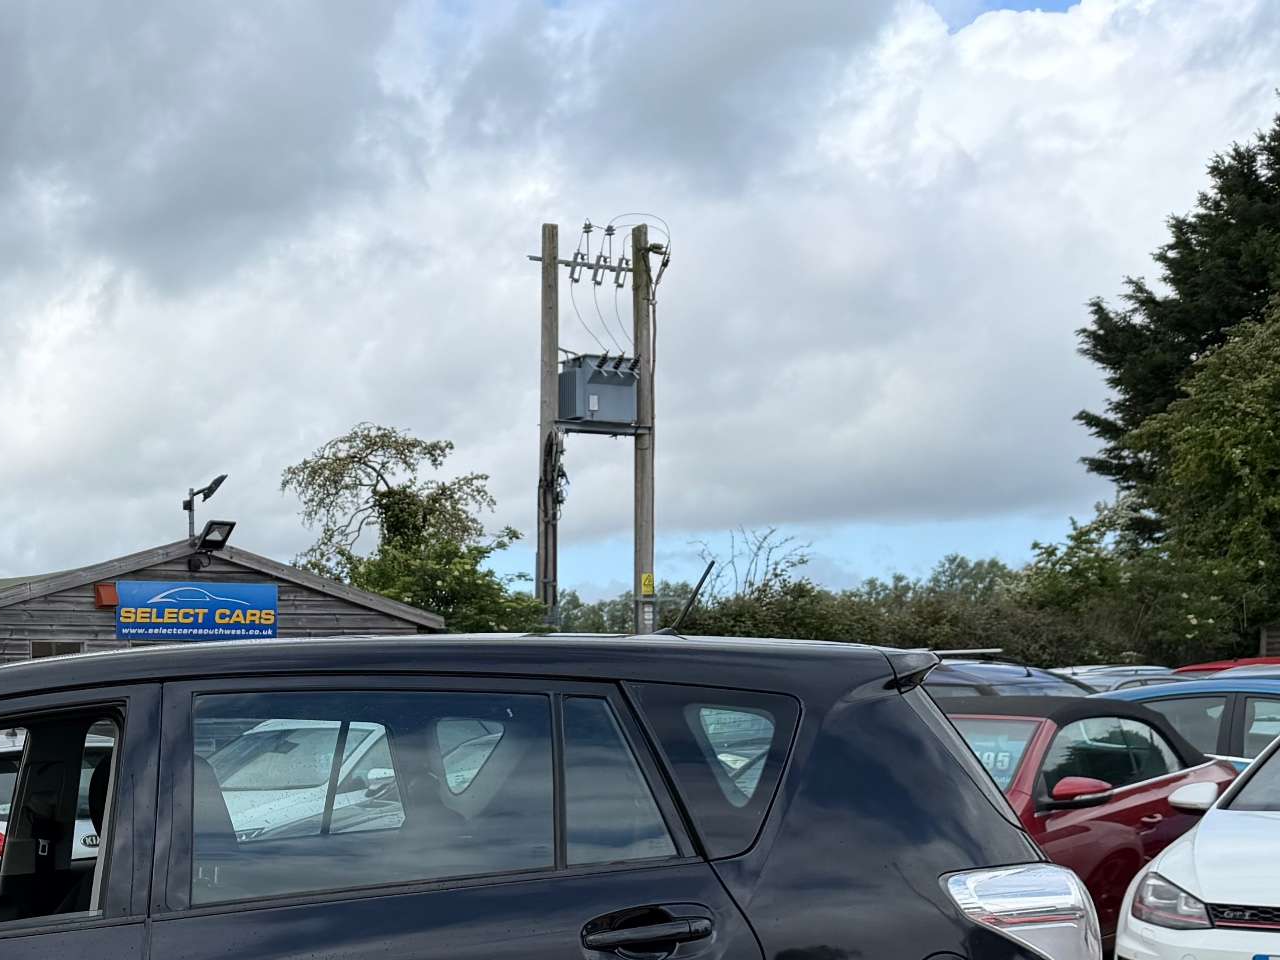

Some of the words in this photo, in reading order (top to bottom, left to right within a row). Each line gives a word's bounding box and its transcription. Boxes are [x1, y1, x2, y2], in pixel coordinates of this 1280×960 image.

[120, 607, 209, 624] SELECT
[214, 608, 276, 625] CARS
[976, 751, 1011, 770] 95
[1223, 910, 1249, 920] GTI
